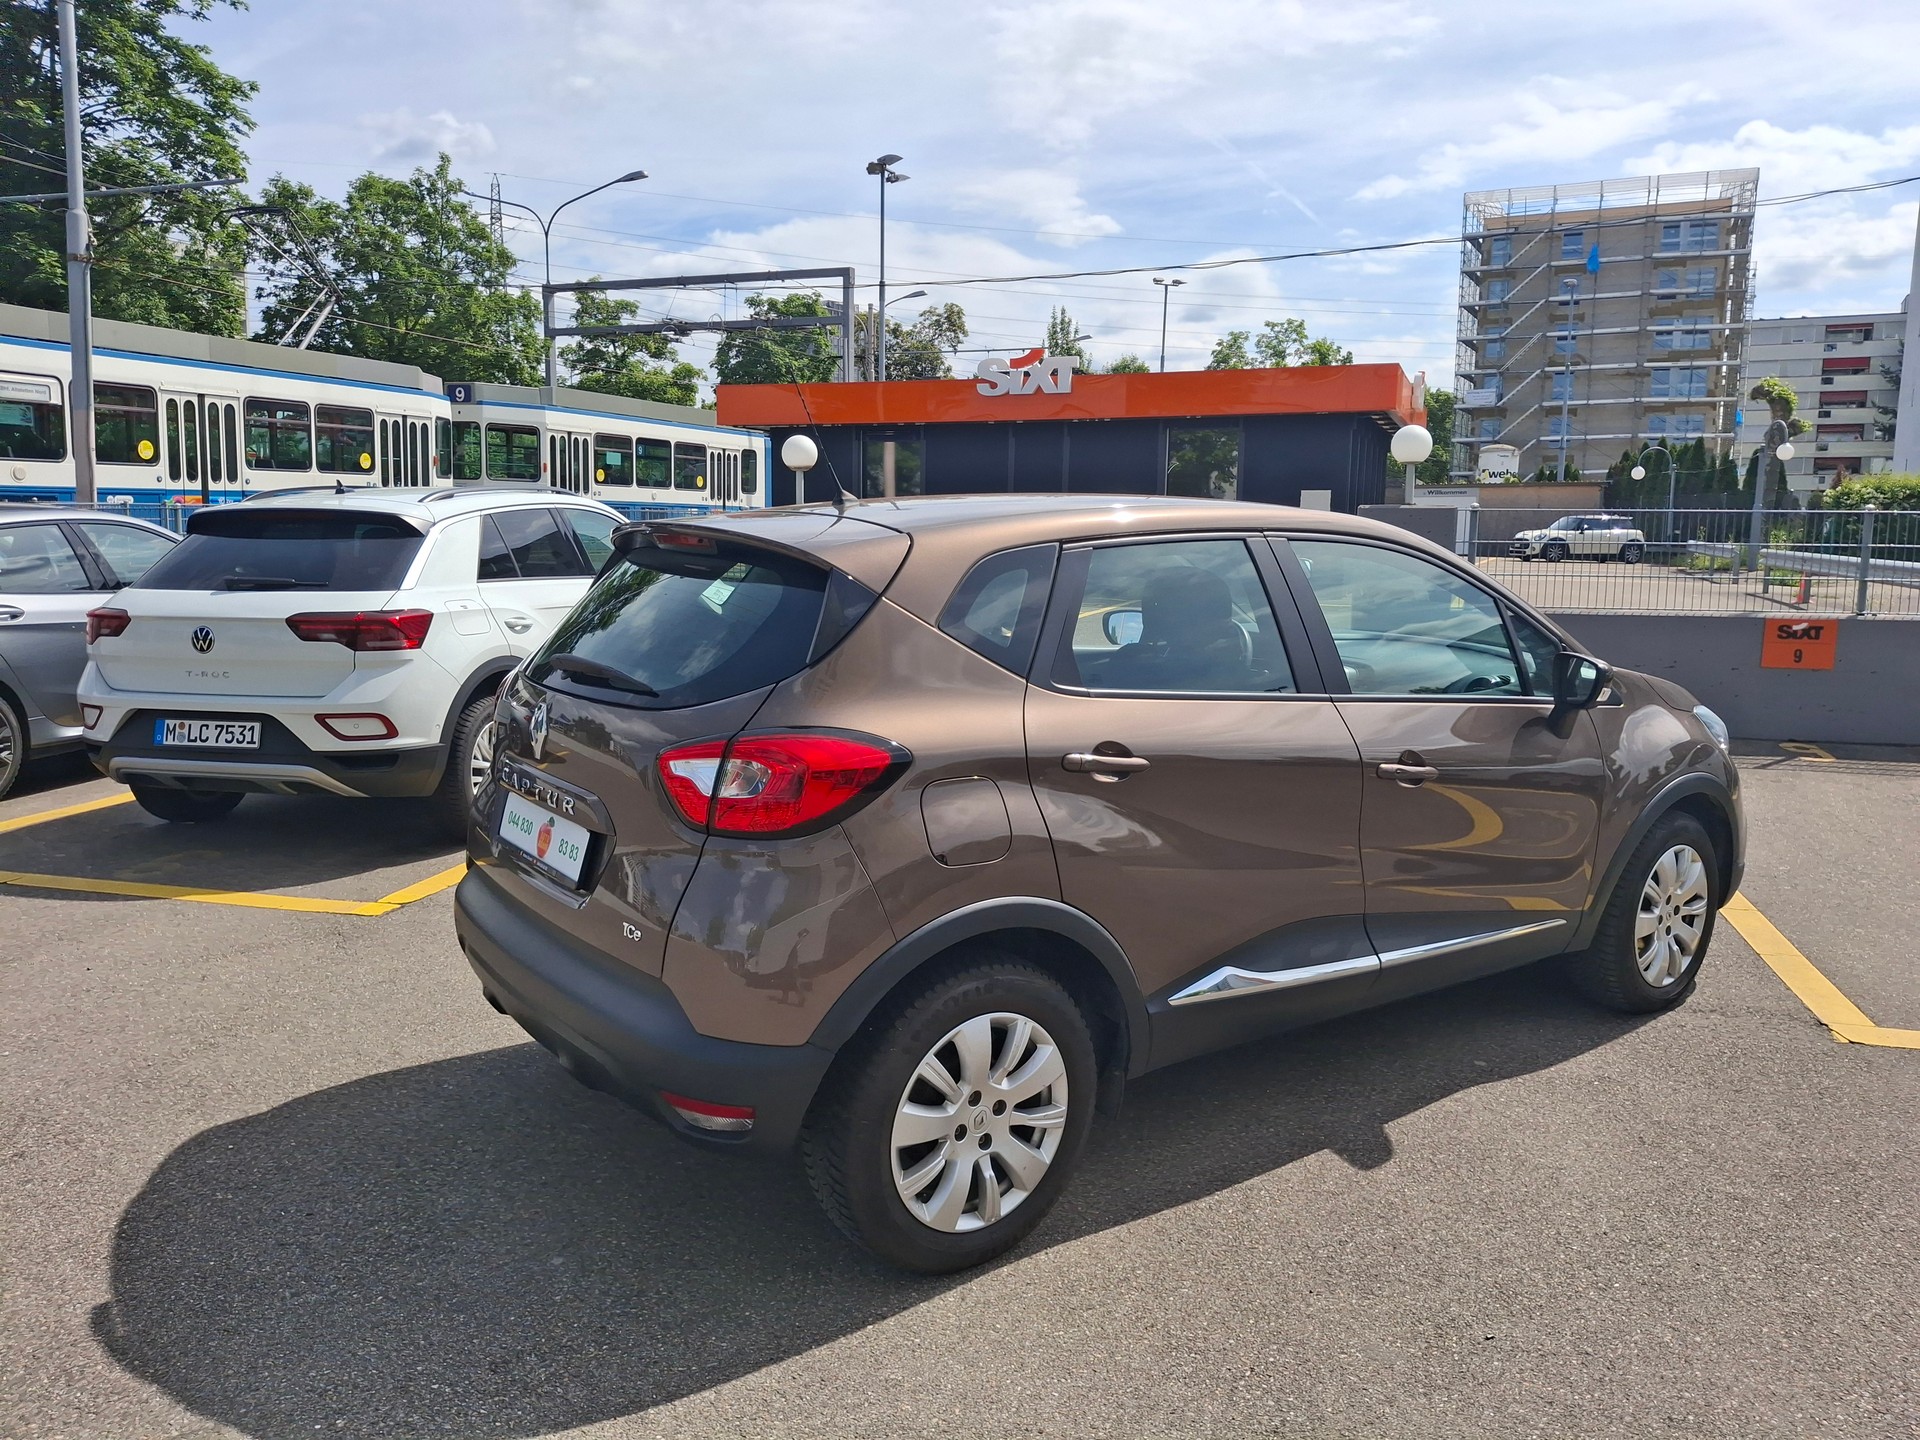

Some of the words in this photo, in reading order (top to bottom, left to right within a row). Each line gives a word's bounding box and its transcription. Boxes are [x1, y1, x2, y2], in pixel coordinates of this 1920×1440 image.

[976, 348, 1080, 397] SIXT
[455, 387, 465, 402] 9
[1776, 624, 1825, 641] SIXT
[1793, 648, 1803, 663] 9
[185, 670, 230, 679] T-ROC
[165, 722, 177, 743] M
[186, 723, 210, 744] LC
[214, 724, 257, 745] 7531
[501, 766, 576, 816] CAPTUR
[507, 810, 520, 829] 044
[520, 817, 534, 836] 830
[558, 838, 569, 856] 83
[568, 843, 580, 862] 83
[622, 921, 642, 942] TCe
